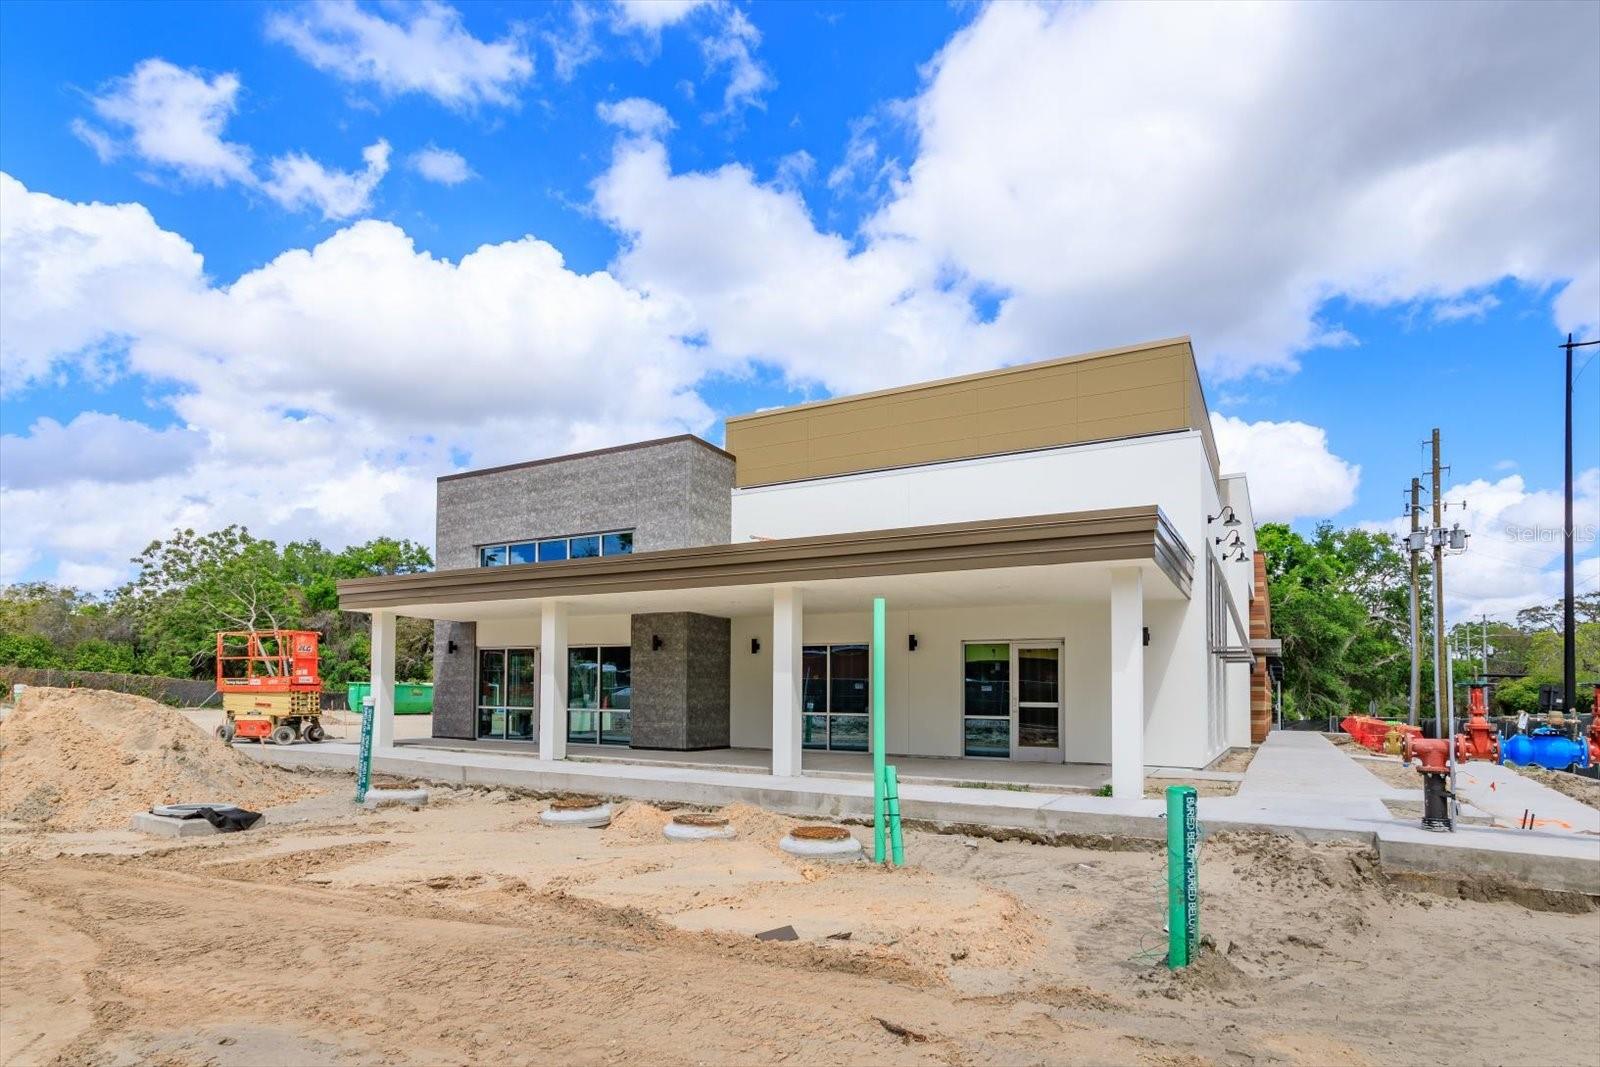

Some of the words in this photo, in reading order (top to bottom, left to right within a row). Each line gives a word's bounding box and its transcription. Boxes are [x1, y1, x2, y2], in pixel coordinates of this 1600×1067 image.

[1186, 796, 1195, 830] BURIED
[1187, 867, 1196, 901] BURIED
[1188, 902, 1197, 934] BELOW
